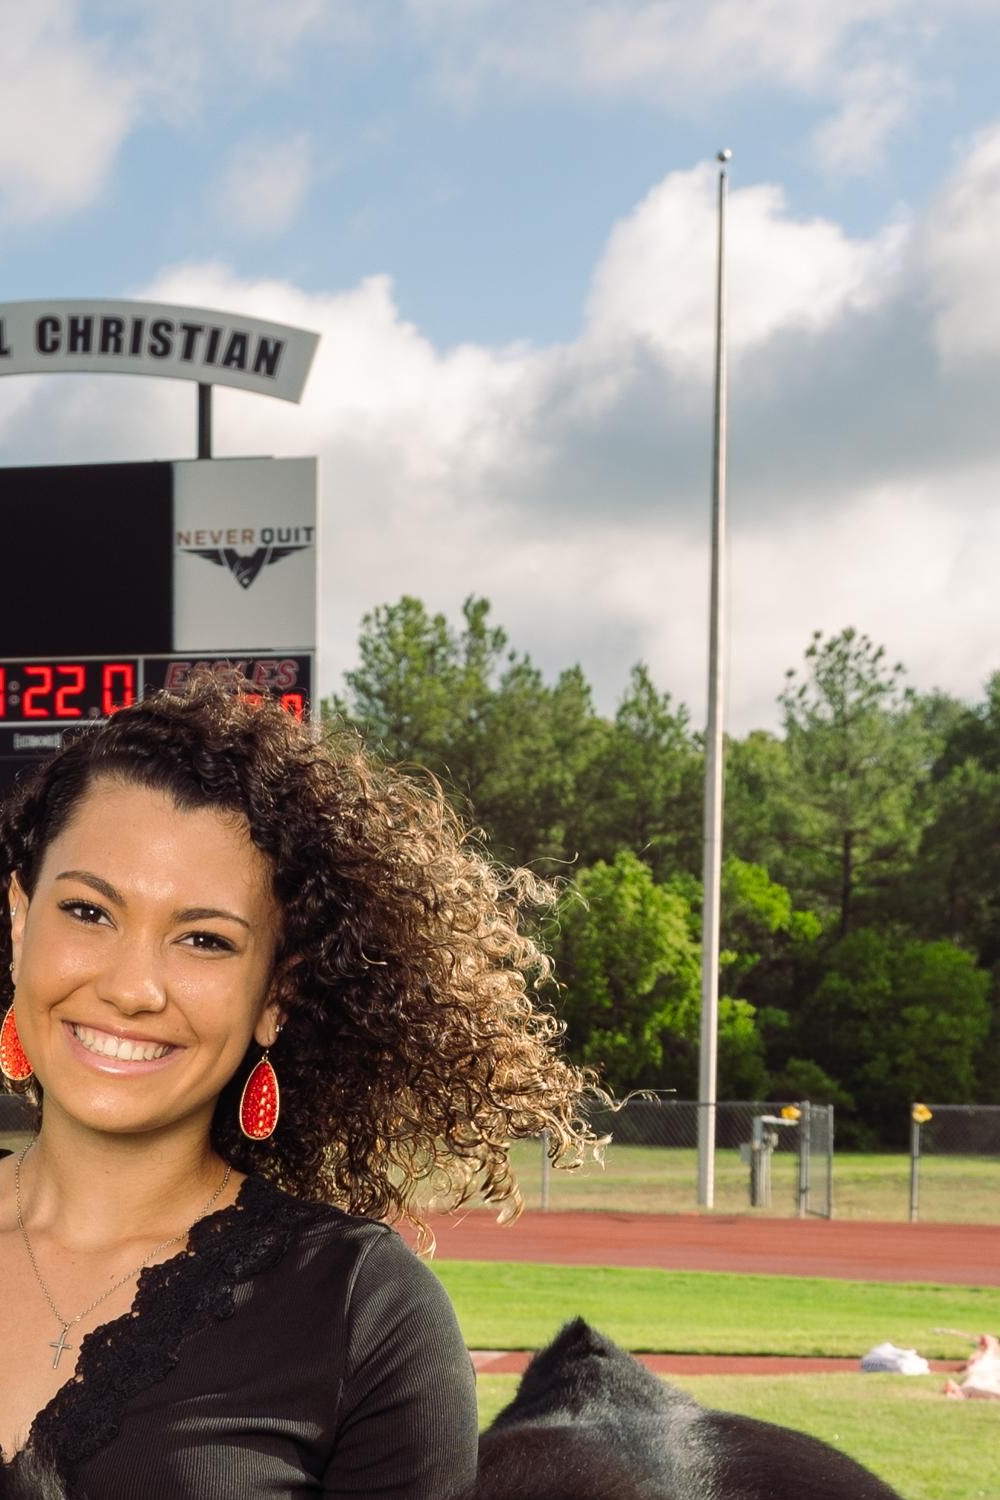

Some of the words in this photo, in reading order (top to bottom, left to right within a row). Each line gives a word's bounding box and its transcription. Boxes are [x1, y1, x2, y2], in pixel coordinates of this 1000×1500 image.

[34, 314, 285, 380] CHRISTIAN
[176, 528, 255, 546] NEVER
[261, 526, 315, 544] QUIT
